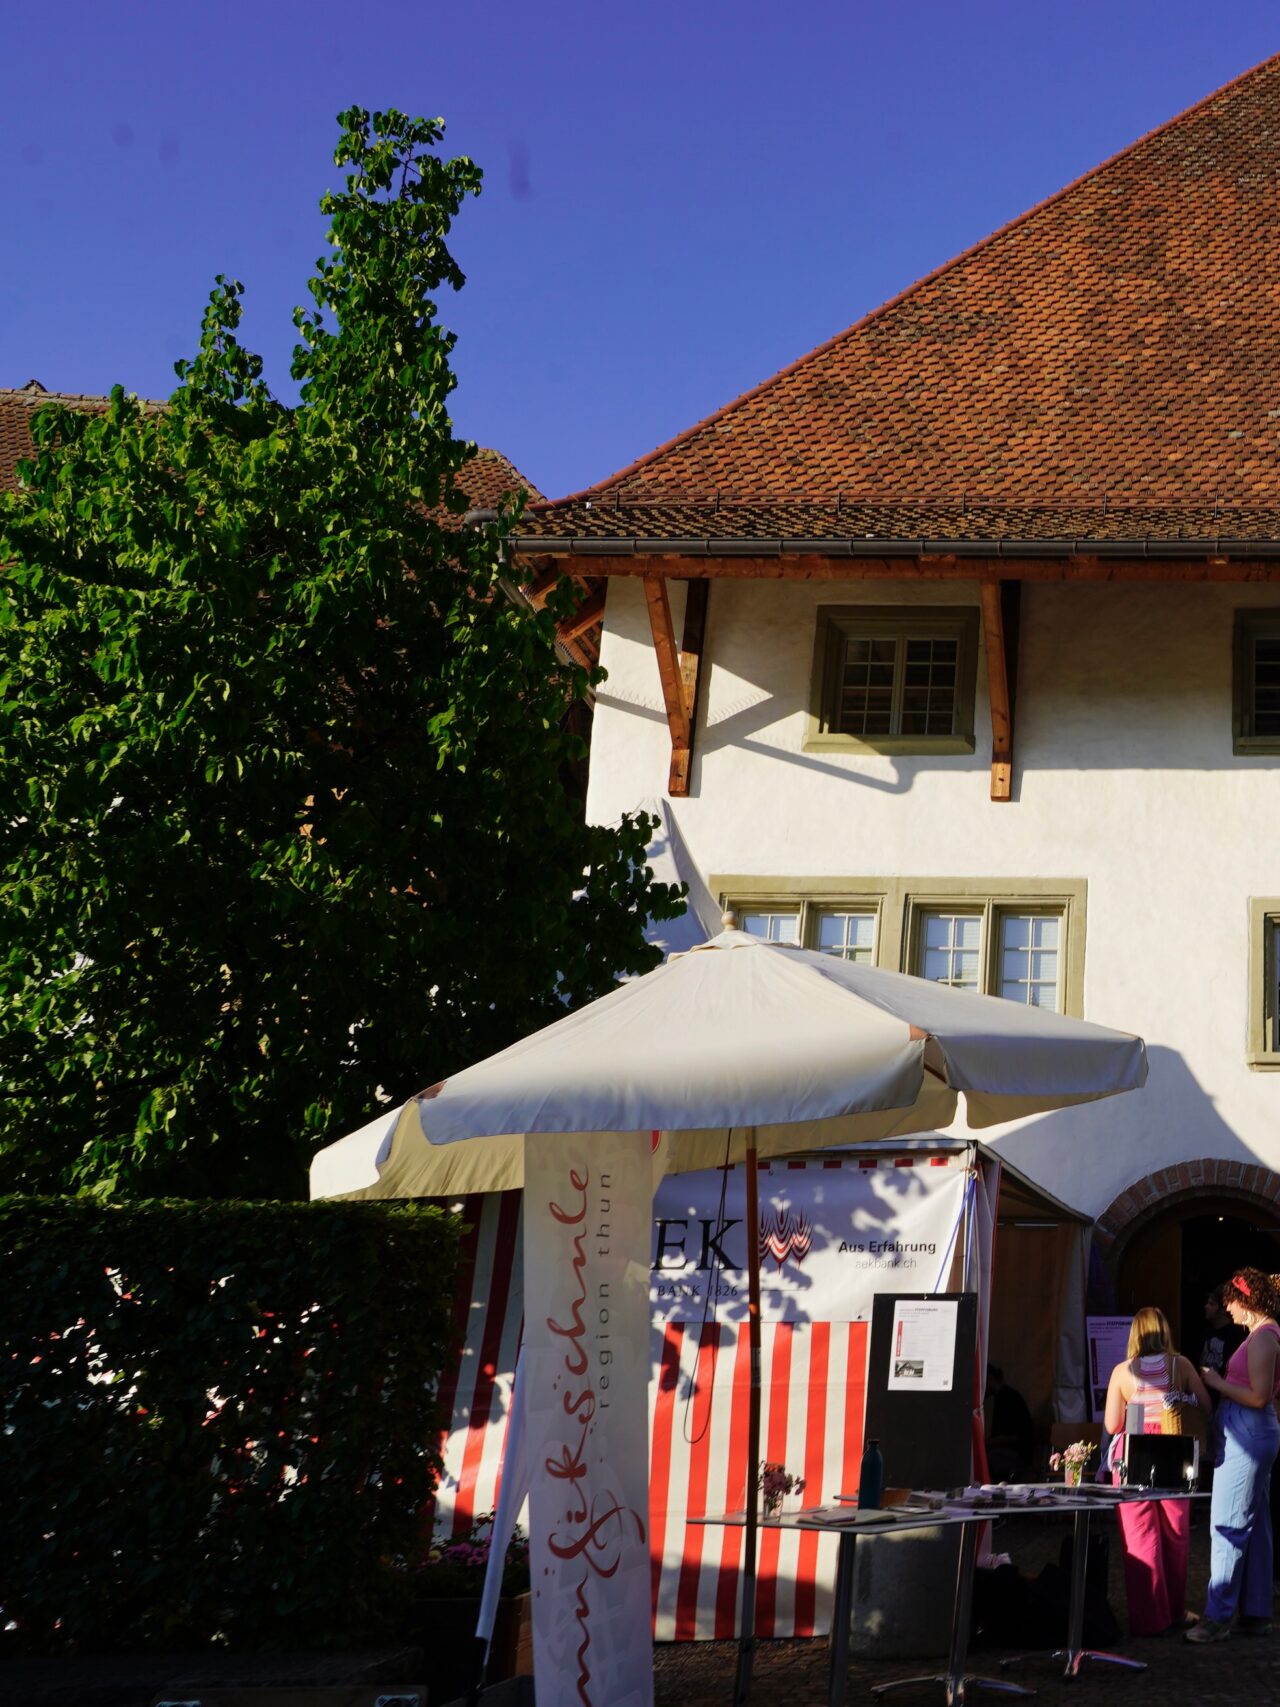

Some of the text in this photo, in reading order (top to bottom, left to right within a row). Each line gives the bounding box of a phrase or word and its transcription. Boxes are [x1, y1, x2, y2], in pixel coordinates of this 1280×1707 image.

[650, 1219, 743, 1270] EK
[838, 1240, 937, 1254] Aus Erfahrung
[855, 1258, 917, 1269] aekbank.ch
[595, 1173, 613, 1409] region thun
[656, 1285, 739, 1297] BANK 1826
